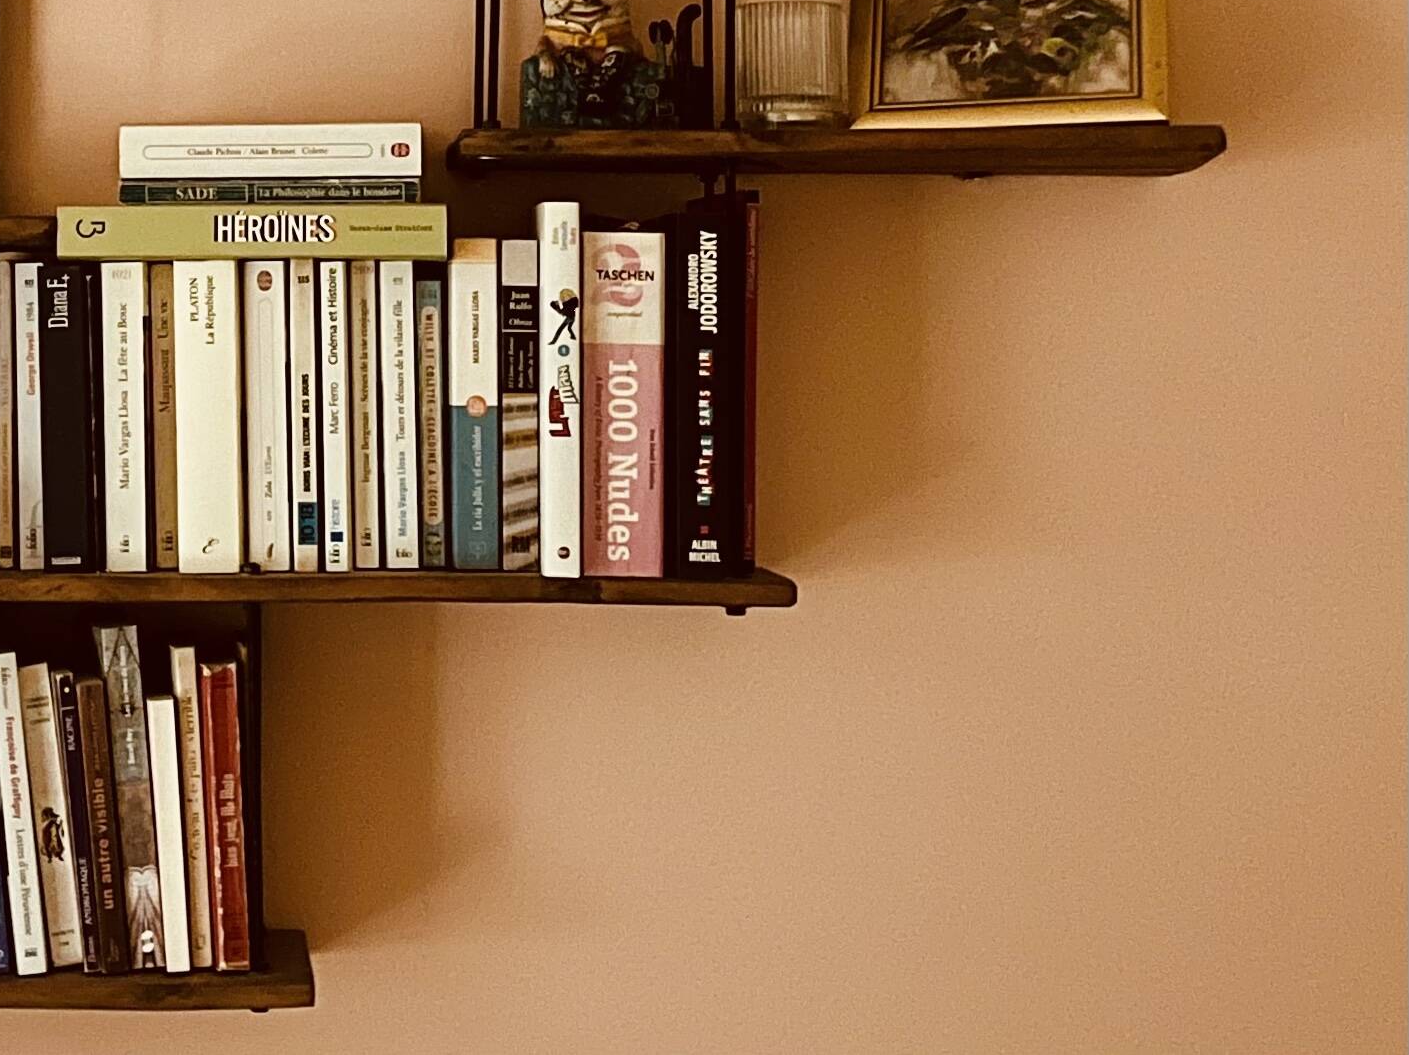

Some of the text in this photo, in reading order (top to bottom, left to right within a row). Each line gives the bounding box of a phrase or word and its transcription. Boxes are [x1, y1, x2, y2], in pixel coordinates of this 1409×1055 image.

[175, 187, 218, 200] SADE
[215, 210, 336, 243] HÉROÏNES
[596, 270, 655, 282] TASCHEN
[687, 253, 699, 310] ALEXANDRO
[698, 230, 718, 334] JODOROWSKY
[47, 290, 69, 329] Diana
[189, 277, 199, 322] PLATON
[205, 276, 216, 345] La République
[393, 299, 403, 317] fille
[117, 304, 128, 329] Bouc
[471, 314, 480, 339] VARGAS
[120, 331, 128, 345] au
[395, 320, 404, 348] vilaine
[326, 267, 339, 435] Marc Ferro Cinéma et Histoire
[395, 349, 404, 358] la
[395, 359, 404, 370] de
[118, 369, 129, 382] La
[426, 365, 436, 405] COLETTE
[118, 391, 129, 418] Llosa
[397, 406, 405, 415] et
[119, 420, 131, 456] Vargas
[301, 373, 311, 492] BORIS DES JOURS
[119, 458, 131, 490] Mario
[397, 451, 406, 476] Llosa
[607, 359, 639, 561] 1000 Nudes
[398, 477, 408, 508] Vargas
[398, 510, 407, 537] Mario
[6, 716, 18, 761] Françoise
[93, 777, 114, 910] un autre visible
